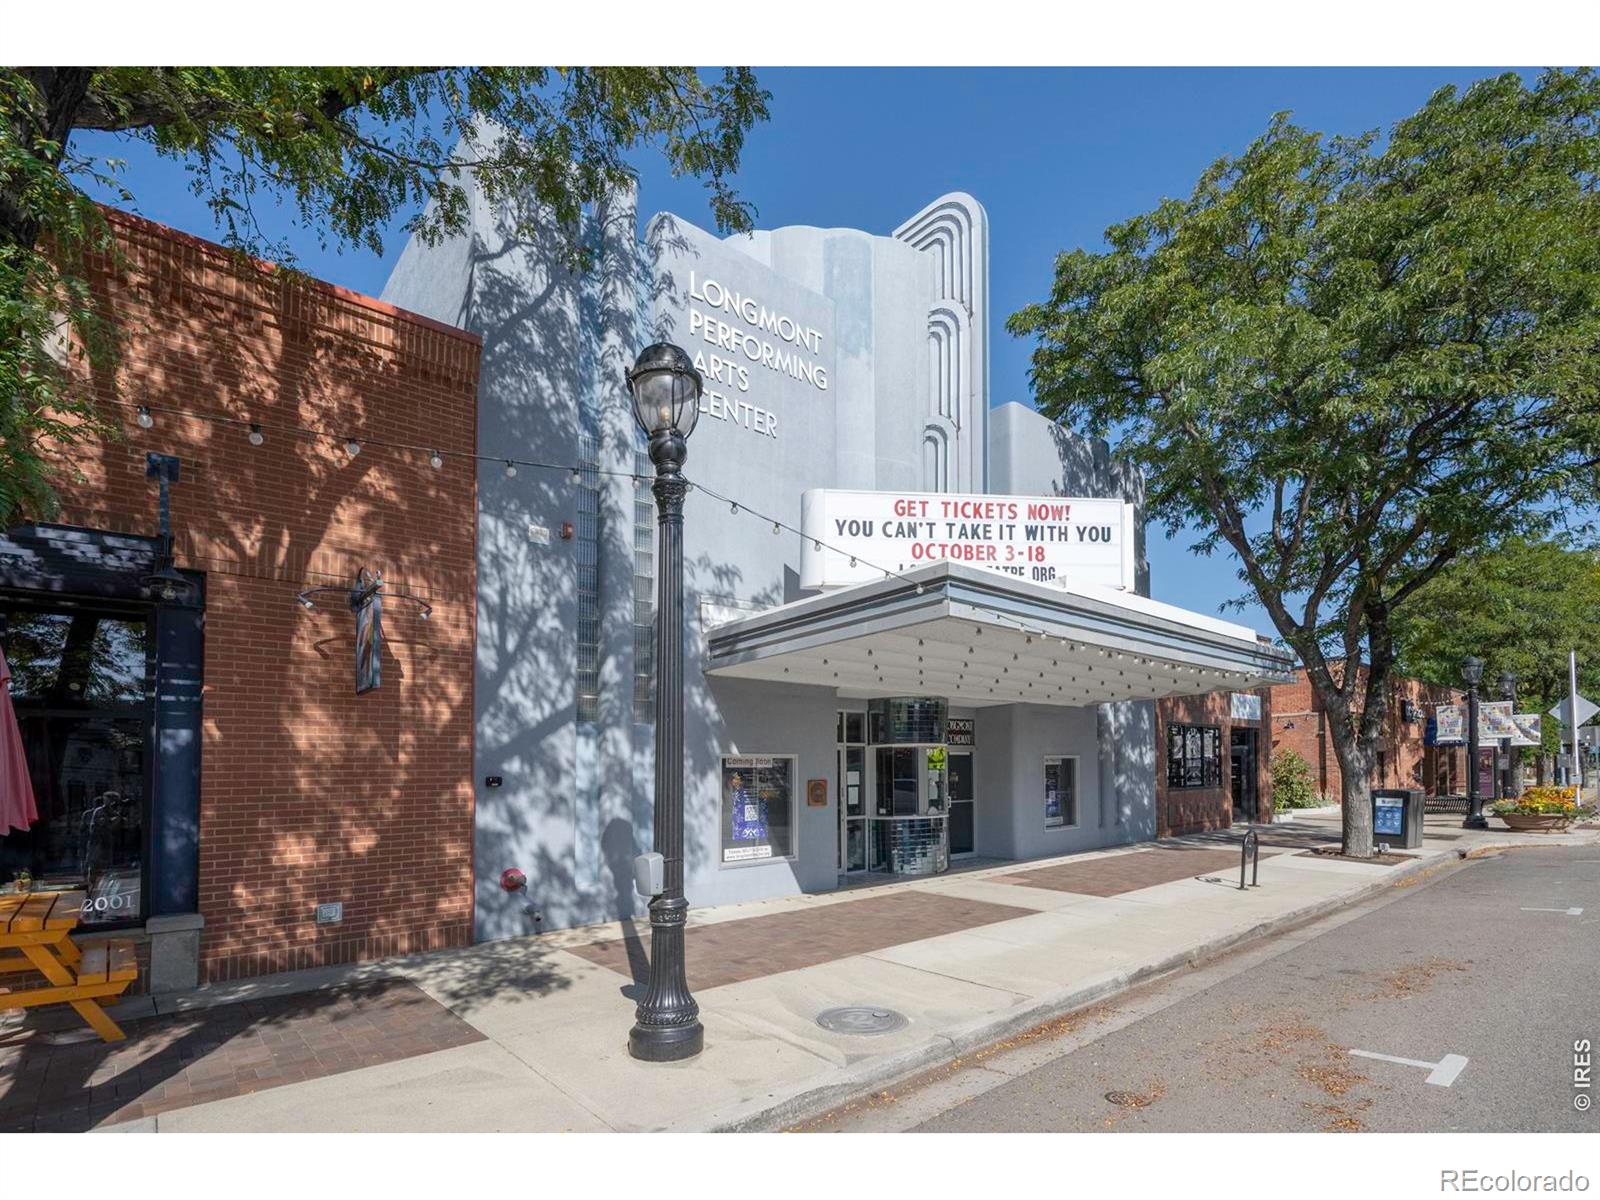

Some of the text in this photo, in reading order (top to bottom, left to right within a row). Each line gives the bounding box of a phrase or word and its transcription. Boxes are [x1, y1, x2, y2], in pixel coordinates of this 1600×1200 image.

[690, 270, 823, 355] LONGMONT
[690, 308, 828, 391] PERFORMING
[693, 350, 750, 393] ARTS
[894, 499, 1071, 522] GET TICKETS NOW!
[835, 519, 1112, 543] YOU CAN'T TAKE IT WITH YOU
[911, 542, 1046, 562] OCTOBER 3-18
[81, 894, 132, 912] 2001
